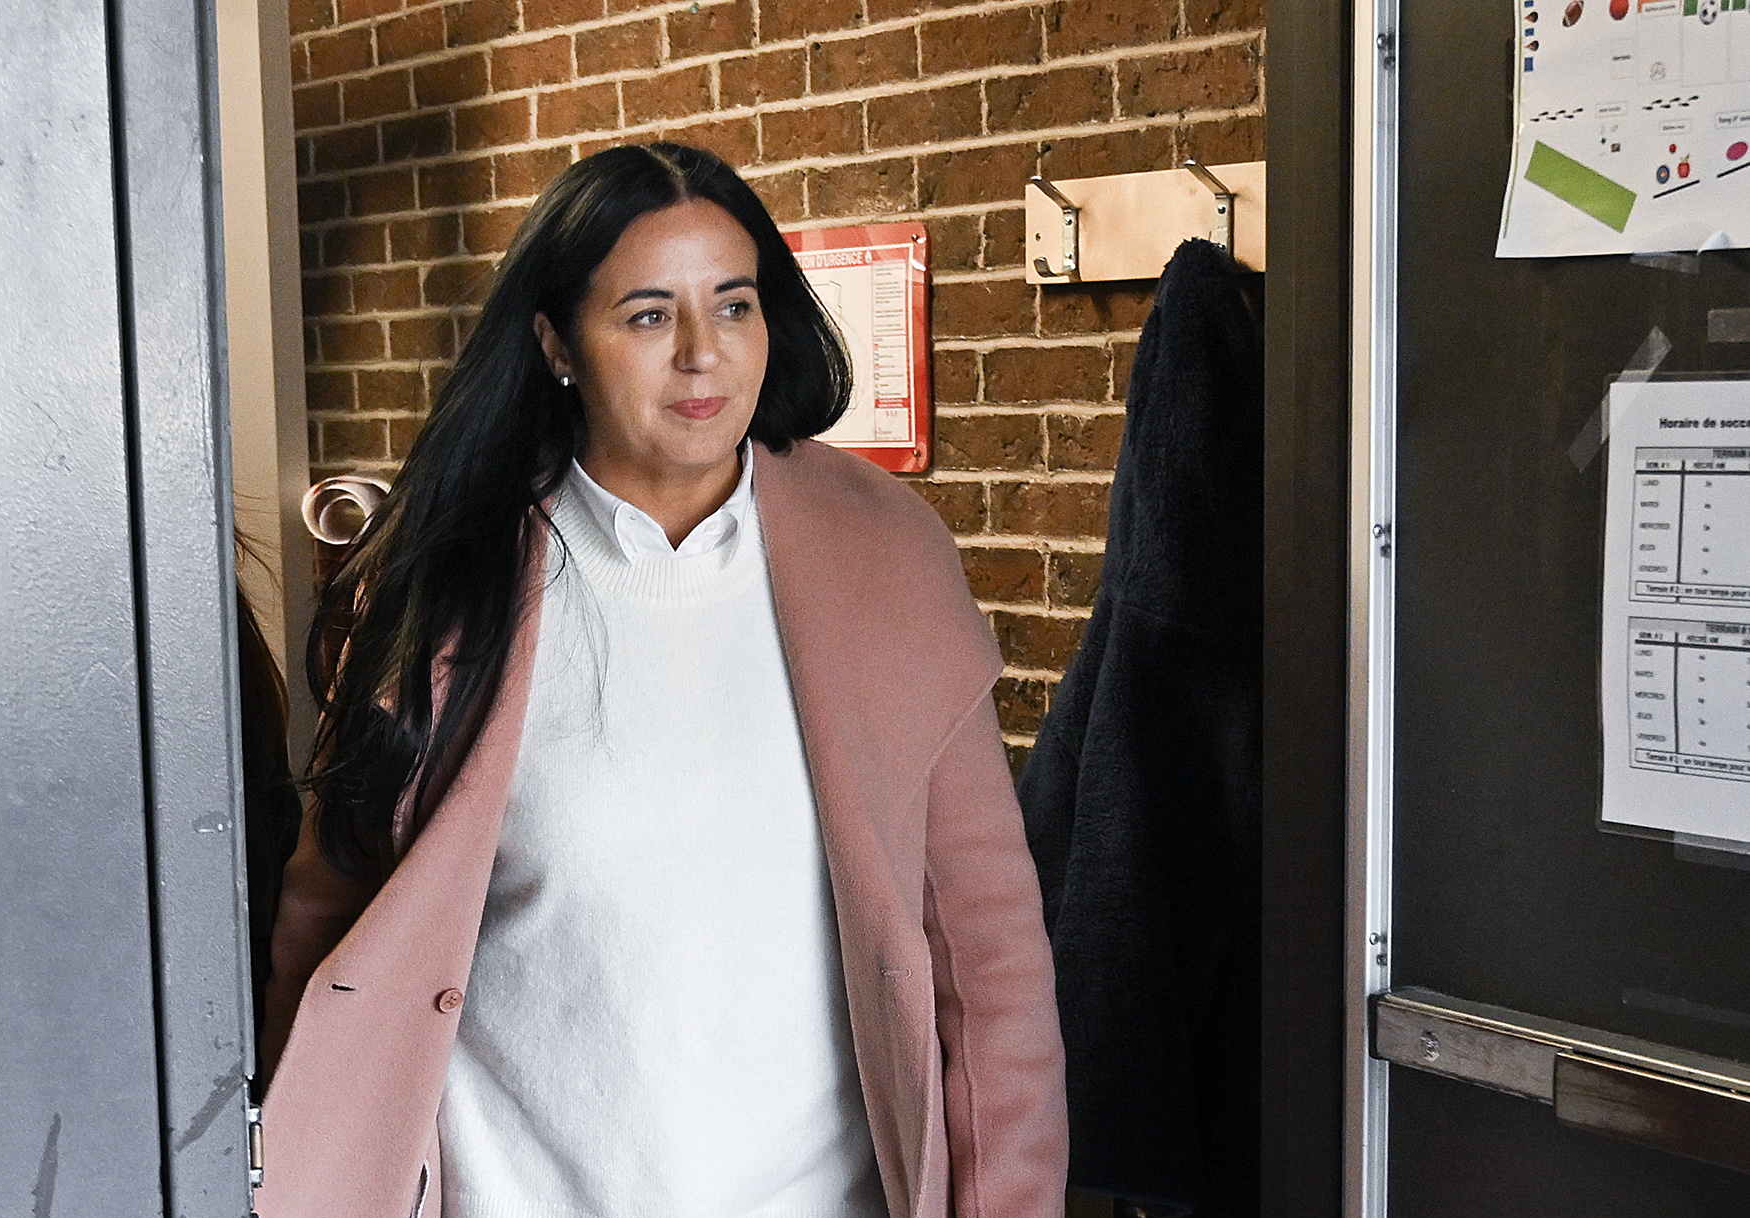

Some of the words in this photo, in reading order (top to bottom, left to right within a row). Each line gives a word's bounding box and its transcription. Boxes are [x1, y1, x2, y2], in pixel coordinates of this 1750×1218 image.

[816, 251, 863, 268] D'URGENCE
[1659, 418, 1699, 428] Horaire
[1702, 417, 1716, 428] de
